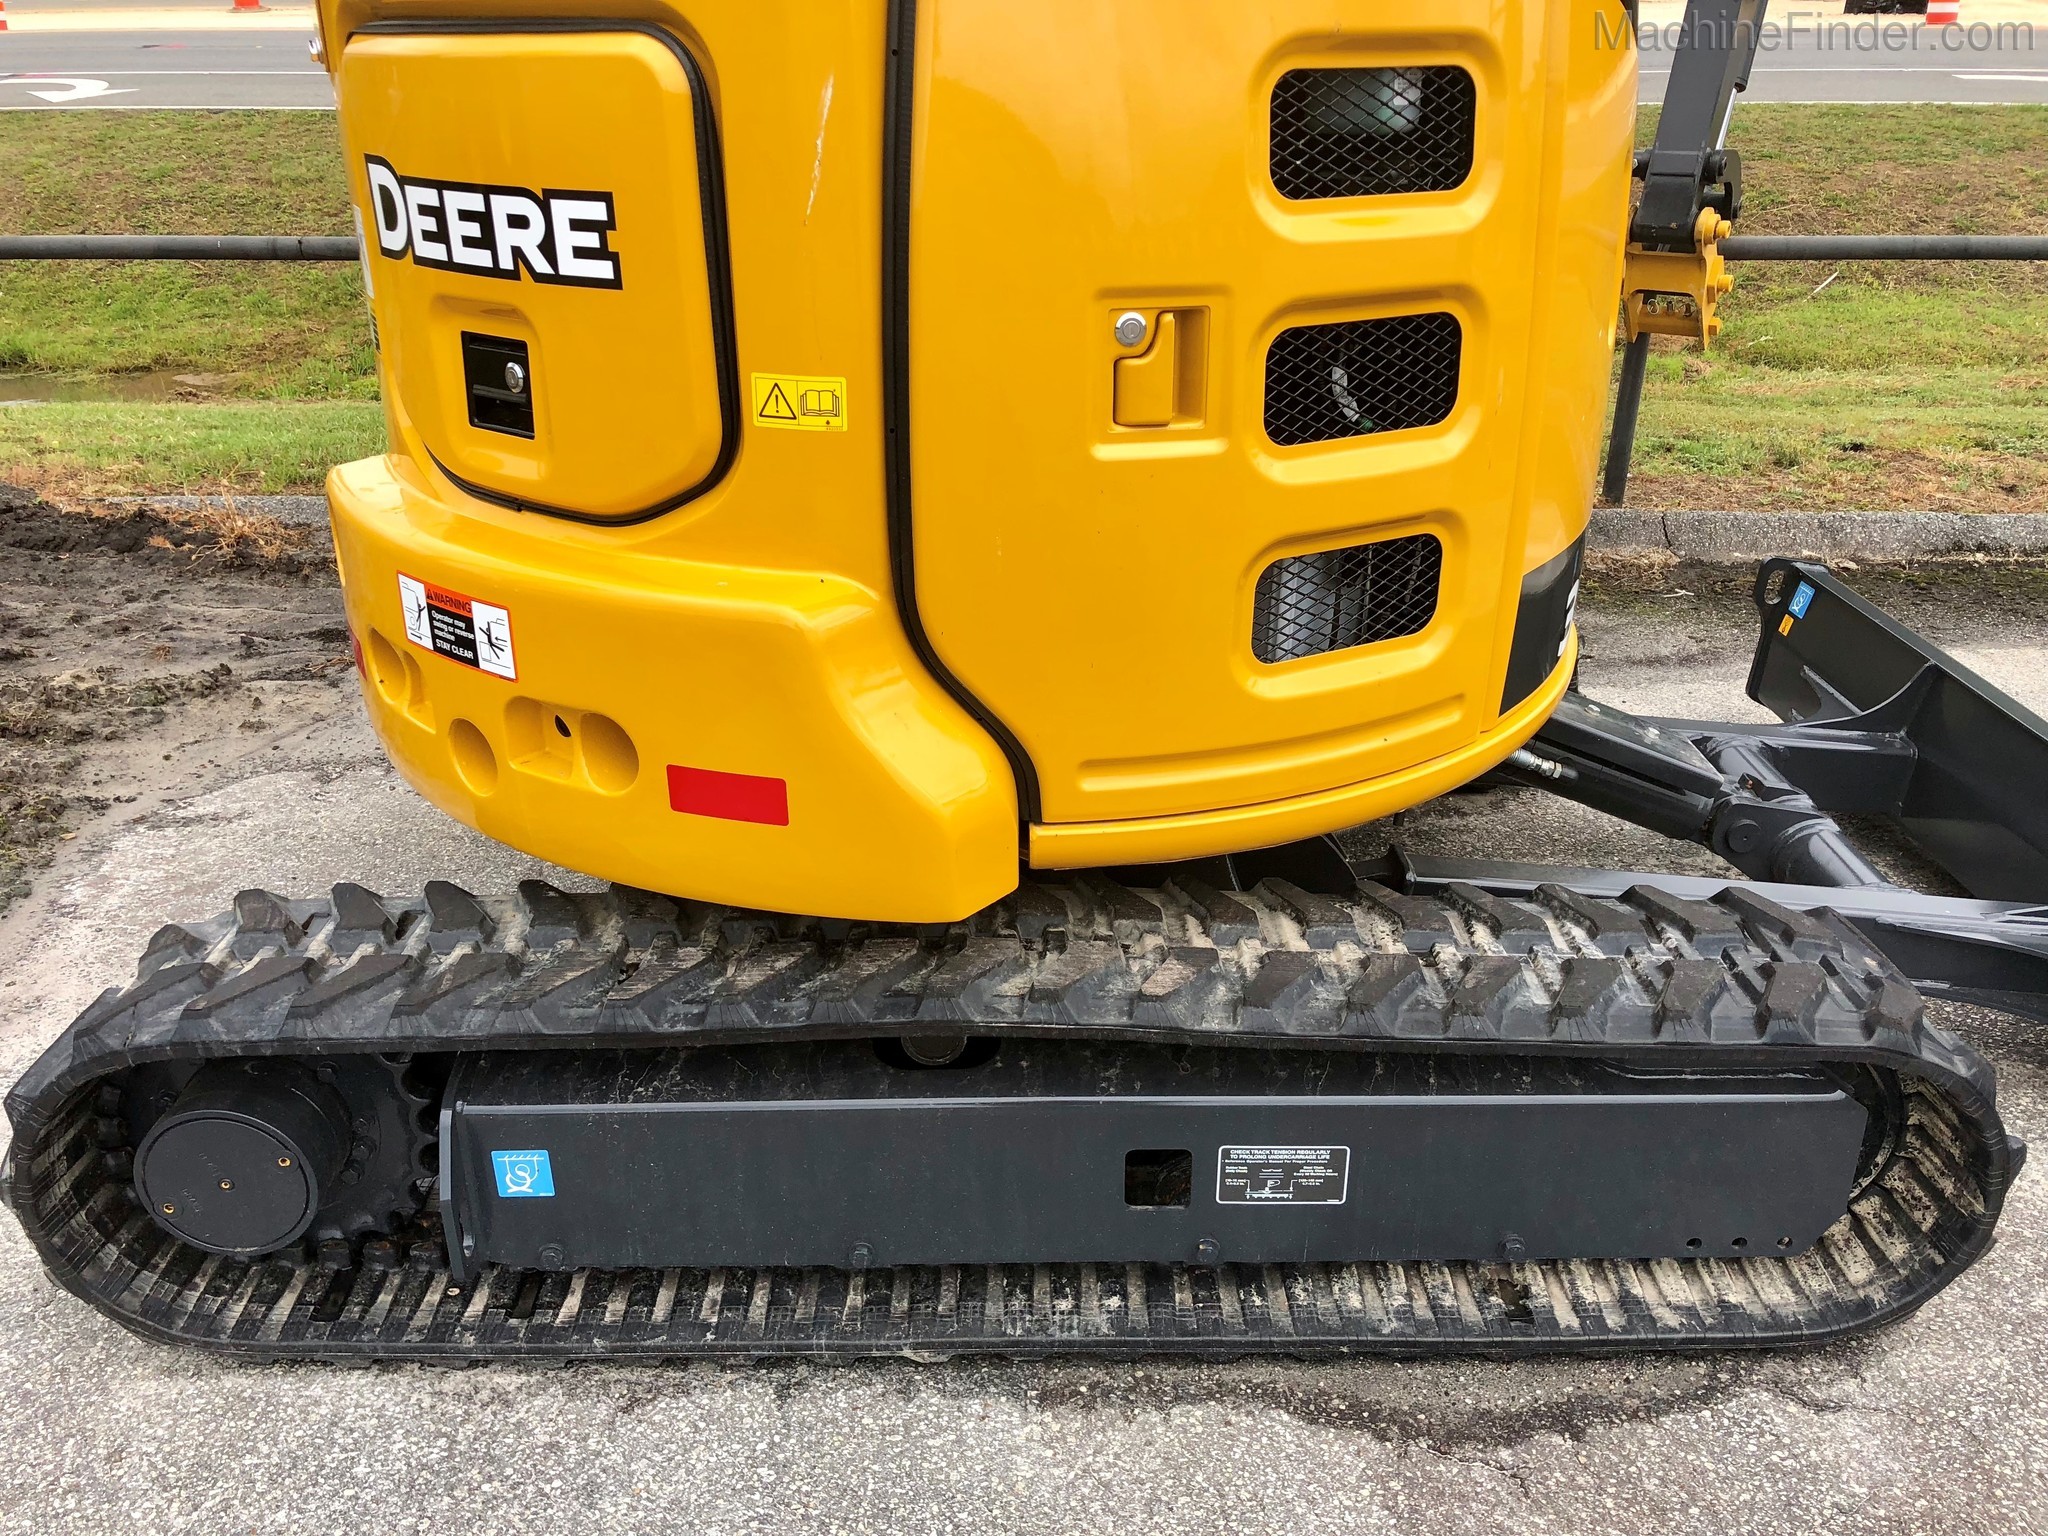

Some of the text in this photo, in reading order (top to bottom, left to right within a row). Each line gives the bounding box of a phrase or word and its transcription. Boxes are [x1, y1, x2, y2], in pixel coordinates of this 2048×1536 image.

[366, 160, 616, 281] DEERE
[432, 591, 472, 613] WARNING
[431, 610, 466, 629] Operator may
[433, 620, 448, 632] swing
[454, 628, 475, 640] reverse
[434, 628, 456, 642] machine
[435, 639, 474, 659] STAY CLEAR
